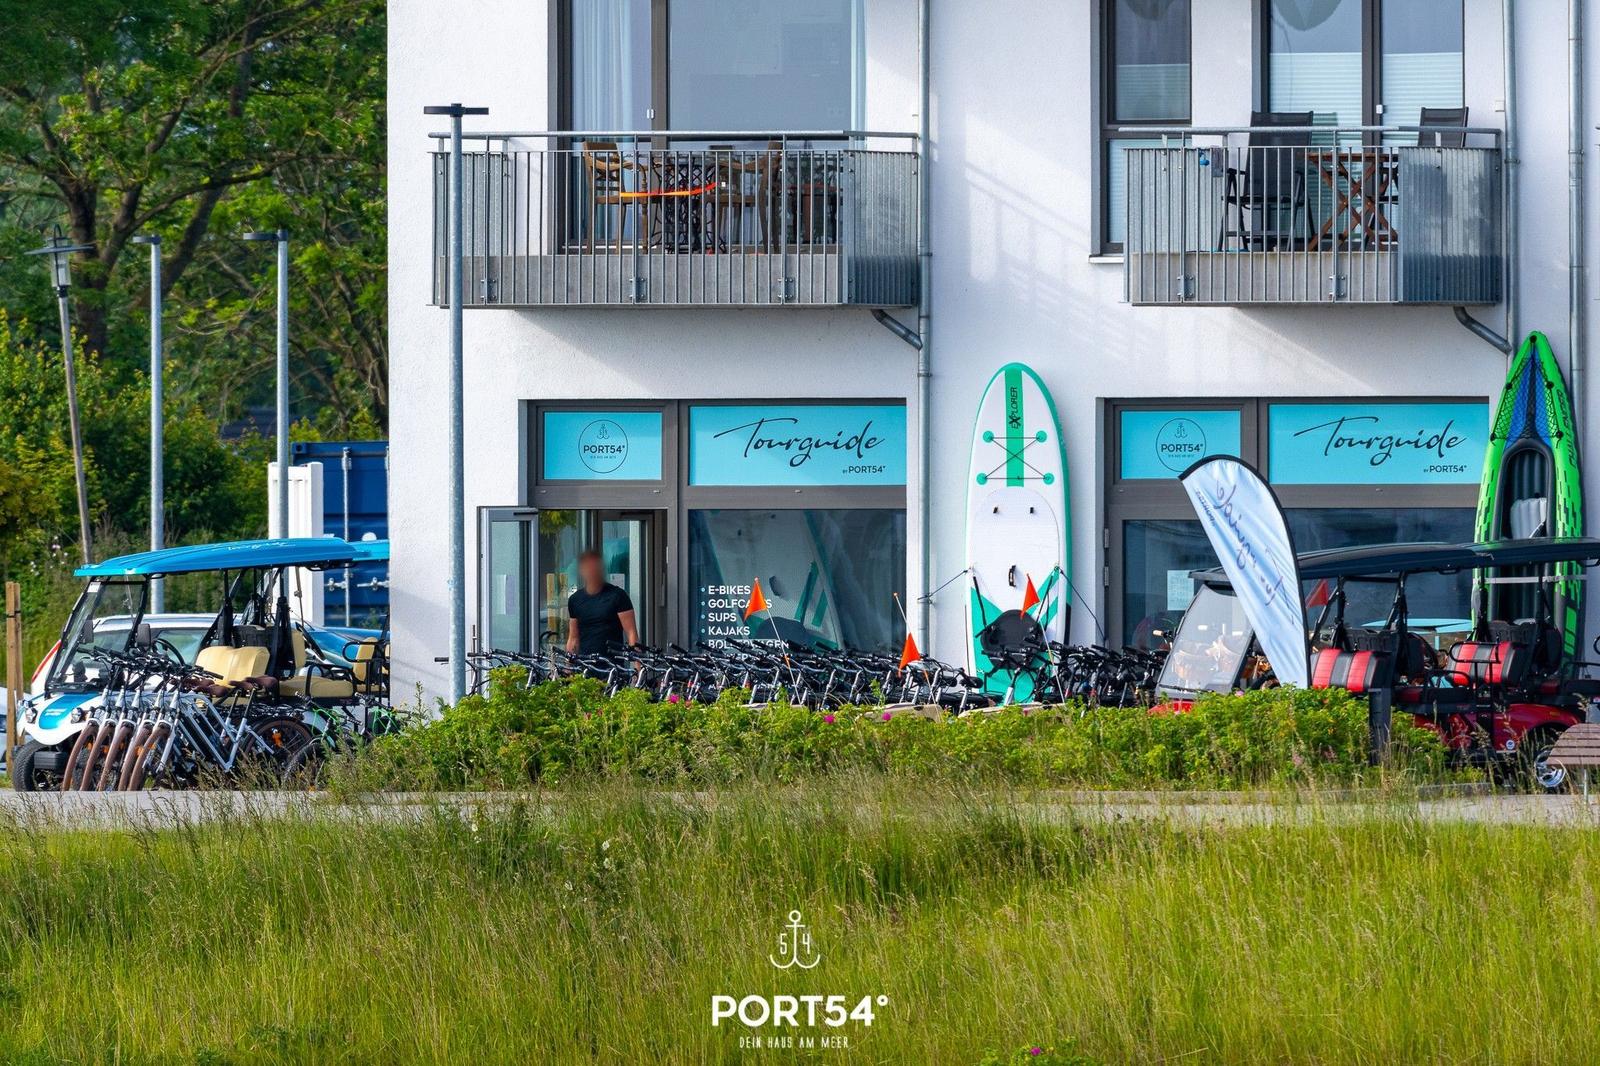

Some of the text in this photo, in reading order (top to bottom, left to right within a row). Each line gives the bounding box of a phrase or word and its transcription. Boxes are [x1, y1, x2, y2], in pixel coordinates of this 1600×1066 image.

[713, 417, 886, 467] Tourguide
[1293, 416, 1467, 466] Tourguide
[708, 585, 751, 595] E-BIKES
[708, 599, 773, 609] GOLFCAS
[708, 612, 737, 622] SUPS
[708, 626, 751, 636] KAJAKS
